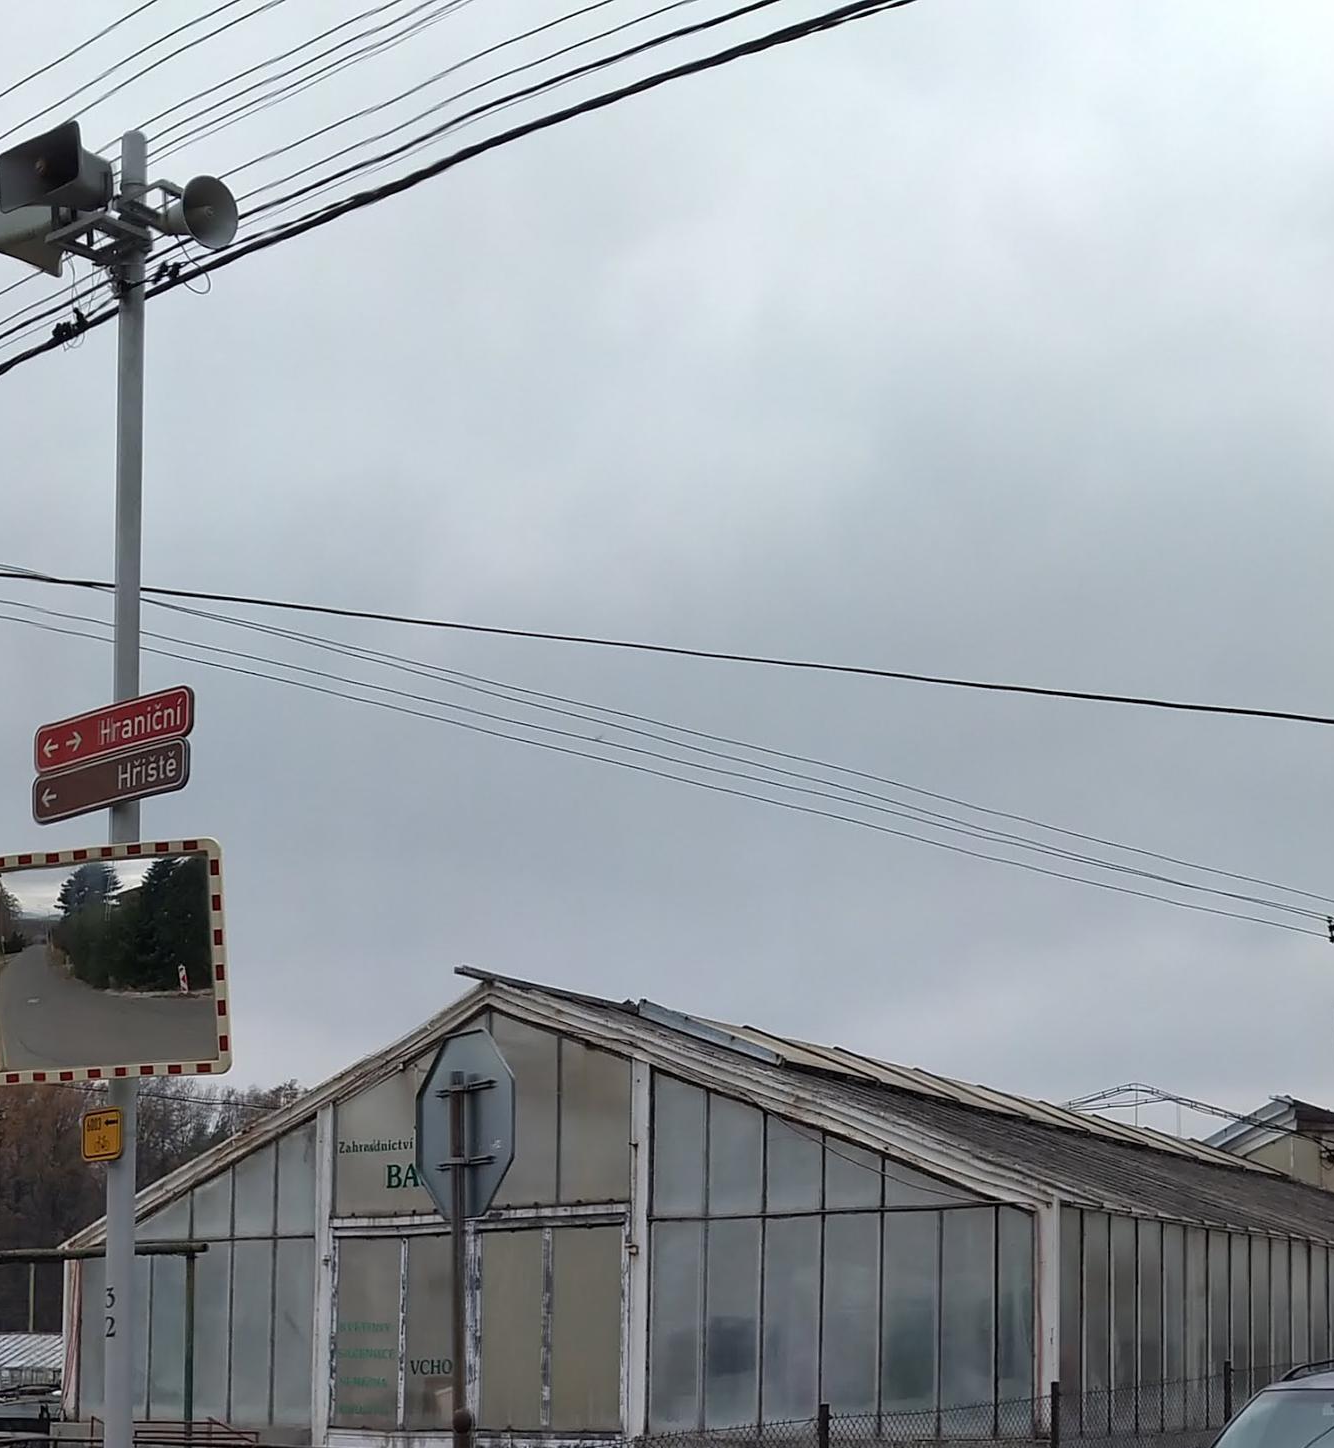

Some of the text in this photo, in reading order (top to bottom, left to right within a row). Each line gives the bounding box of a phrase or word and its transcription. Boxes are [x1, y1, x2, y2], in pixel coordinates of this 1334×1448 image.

[99, 698, 183, 746] Hraniční
[117, 750, 177, 790] Hřiště
[338, 1137, 414, 1154] Zahradnictví
[386, 1163, 425, 1189] BA
[410, 1358, 454, 1375] VCHO
